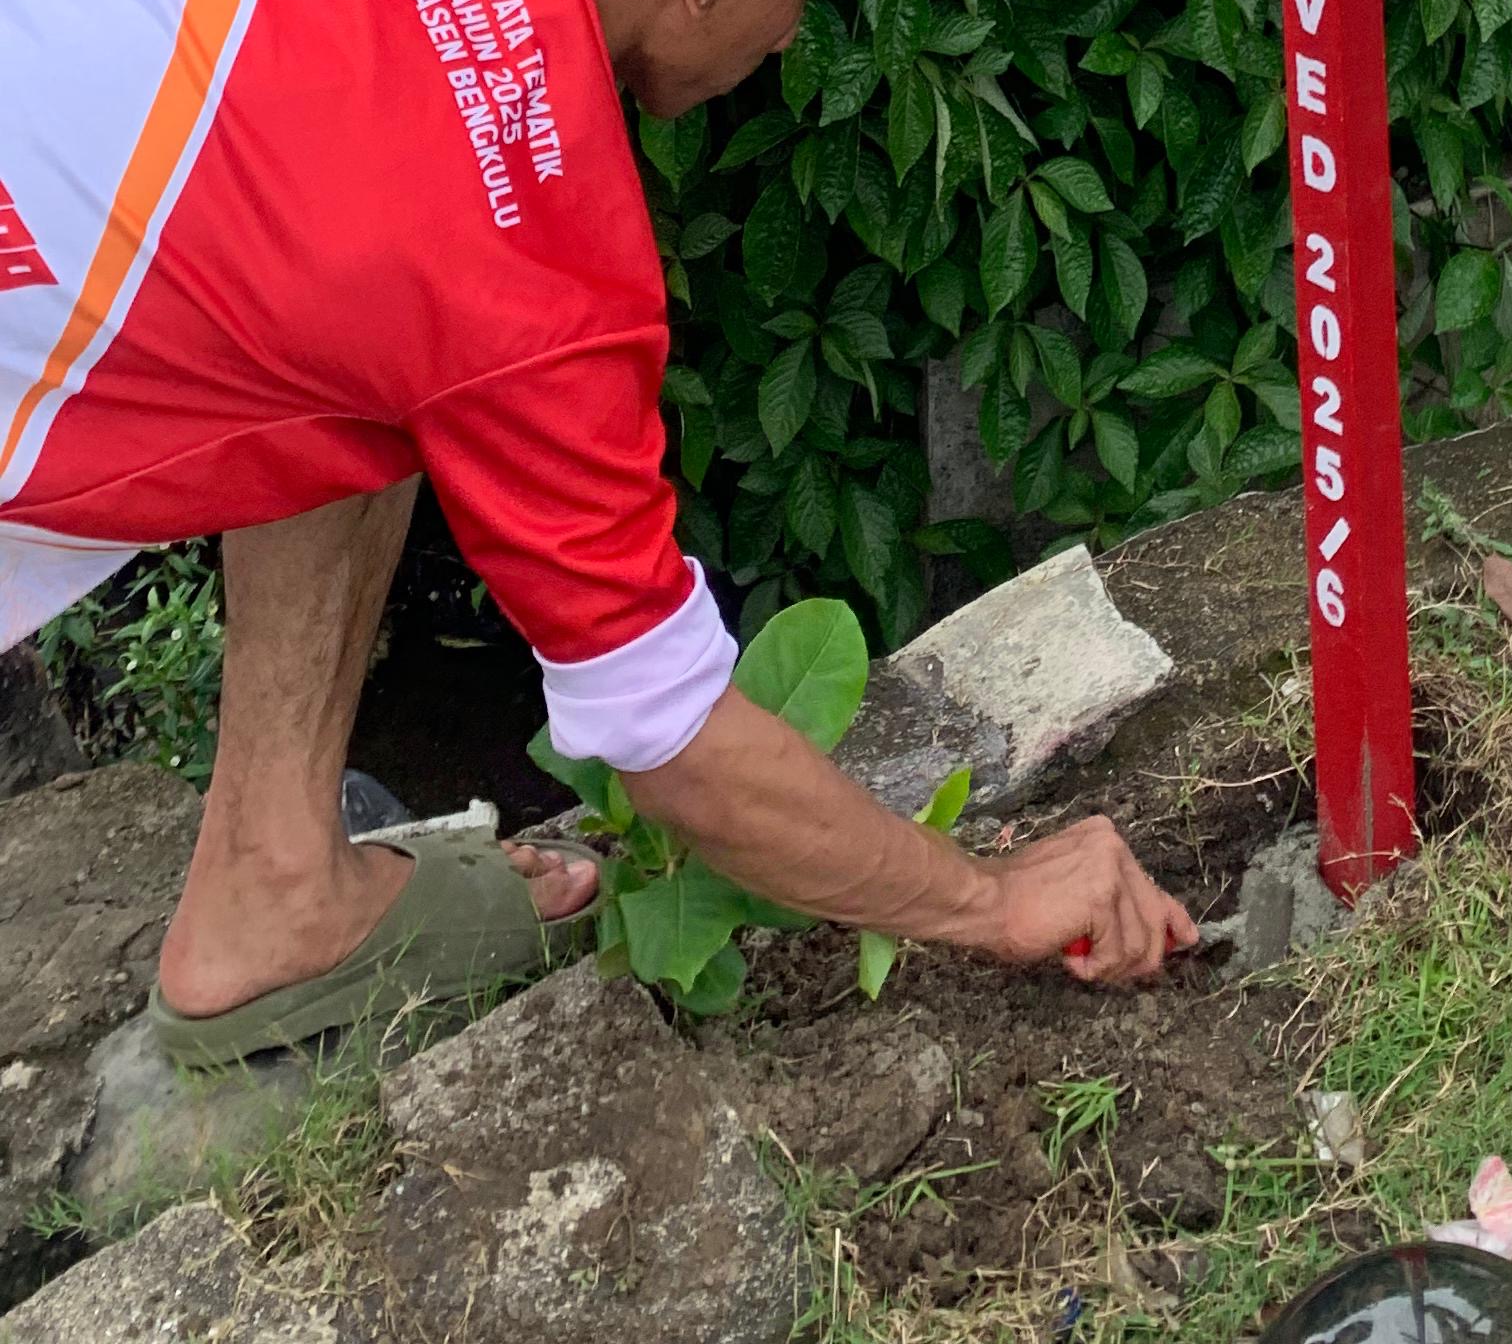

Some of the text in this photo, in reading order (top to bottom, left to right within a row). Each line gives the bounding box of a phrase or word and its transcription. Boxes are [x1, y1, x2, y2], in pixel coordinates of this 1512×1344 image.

[447, 67, 522, 228] BENGKULU
[483, 67, 522, 144] 2025
[517, 48, 563, 183] TEMATIK
[1306, 233, 1351, 627] 2025/6
